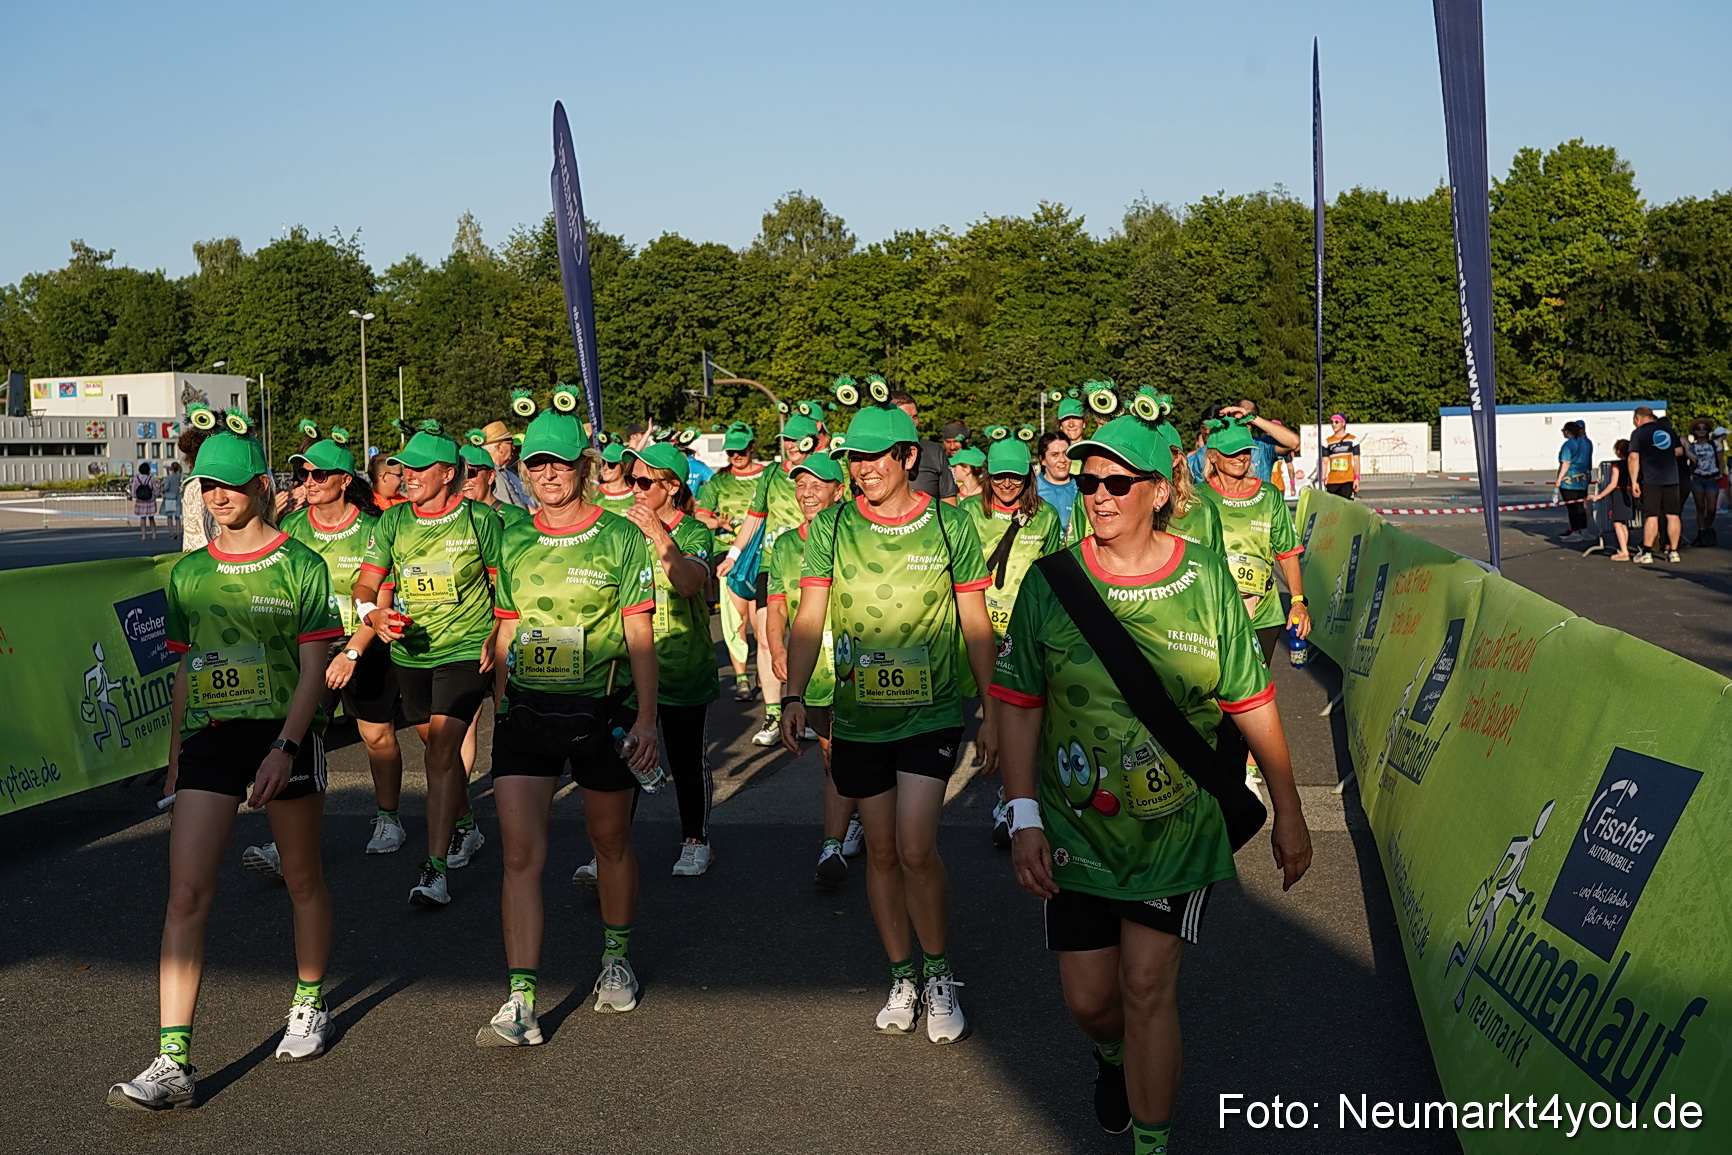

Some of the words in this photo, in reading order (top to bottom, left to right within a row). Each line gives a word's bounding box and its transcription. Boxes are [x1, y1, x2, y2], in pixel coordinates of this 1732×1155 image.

[870, 511, 934, 535] MONSTERSTARK
[537, 526, 600, 547] MONSTERSTARK
[216, 551, 285, 575] MONSTERSTARK
[567, 567, 607, 580] TRENDHAUS
[1237, 566, 1254, 581] 96
[417, 577, 435, 592] 51
[446, 578, 454, 597] 2022
[1107, 568, 1198, 602] MONSTERSTARK
[251, 595, 295, 609] TRENDHAUS
[132, 616, 165, 636] Fischer
[991, 610, 1008, 624] 82
[1166, 629, 1219, 651] TRENDHAUS
[1167, 641, 1217, 661] POWER-TEAM
[534, 646, 558, 665] 87
[572, 649, 580, 675] 2022
[211, 667, 240, 690] 88
[256, 667, 266, 696] 2022
[858, 670, 866, 698] WALK
[877, 668, 905, 688] 86
[919, 669, 928, 697] 2022
[121, 672, 176, 720] firme
[190, 675, 200, 705] WALK
[202, 691, 227, 700] Pfindel
[229, 688, 255, 697] Carina
[866, 688, 885, 696] Meier
[886, 688, 920, 697] Christine
[134, 706, 172, 739] neumar
[1145, 762, 1172, 793] 83
[1122, 774, 1135, 809] WALK
[1136, 791, 1172, 807] Lorusso
[1592, 806, 1655, 855] Fischer
[1587, 843, 1635, 874] AUTOMOBILE
[1498, 892, 1708, 1107] firmenlauf
[1467, 993, 1535, 1070] neumarkt
